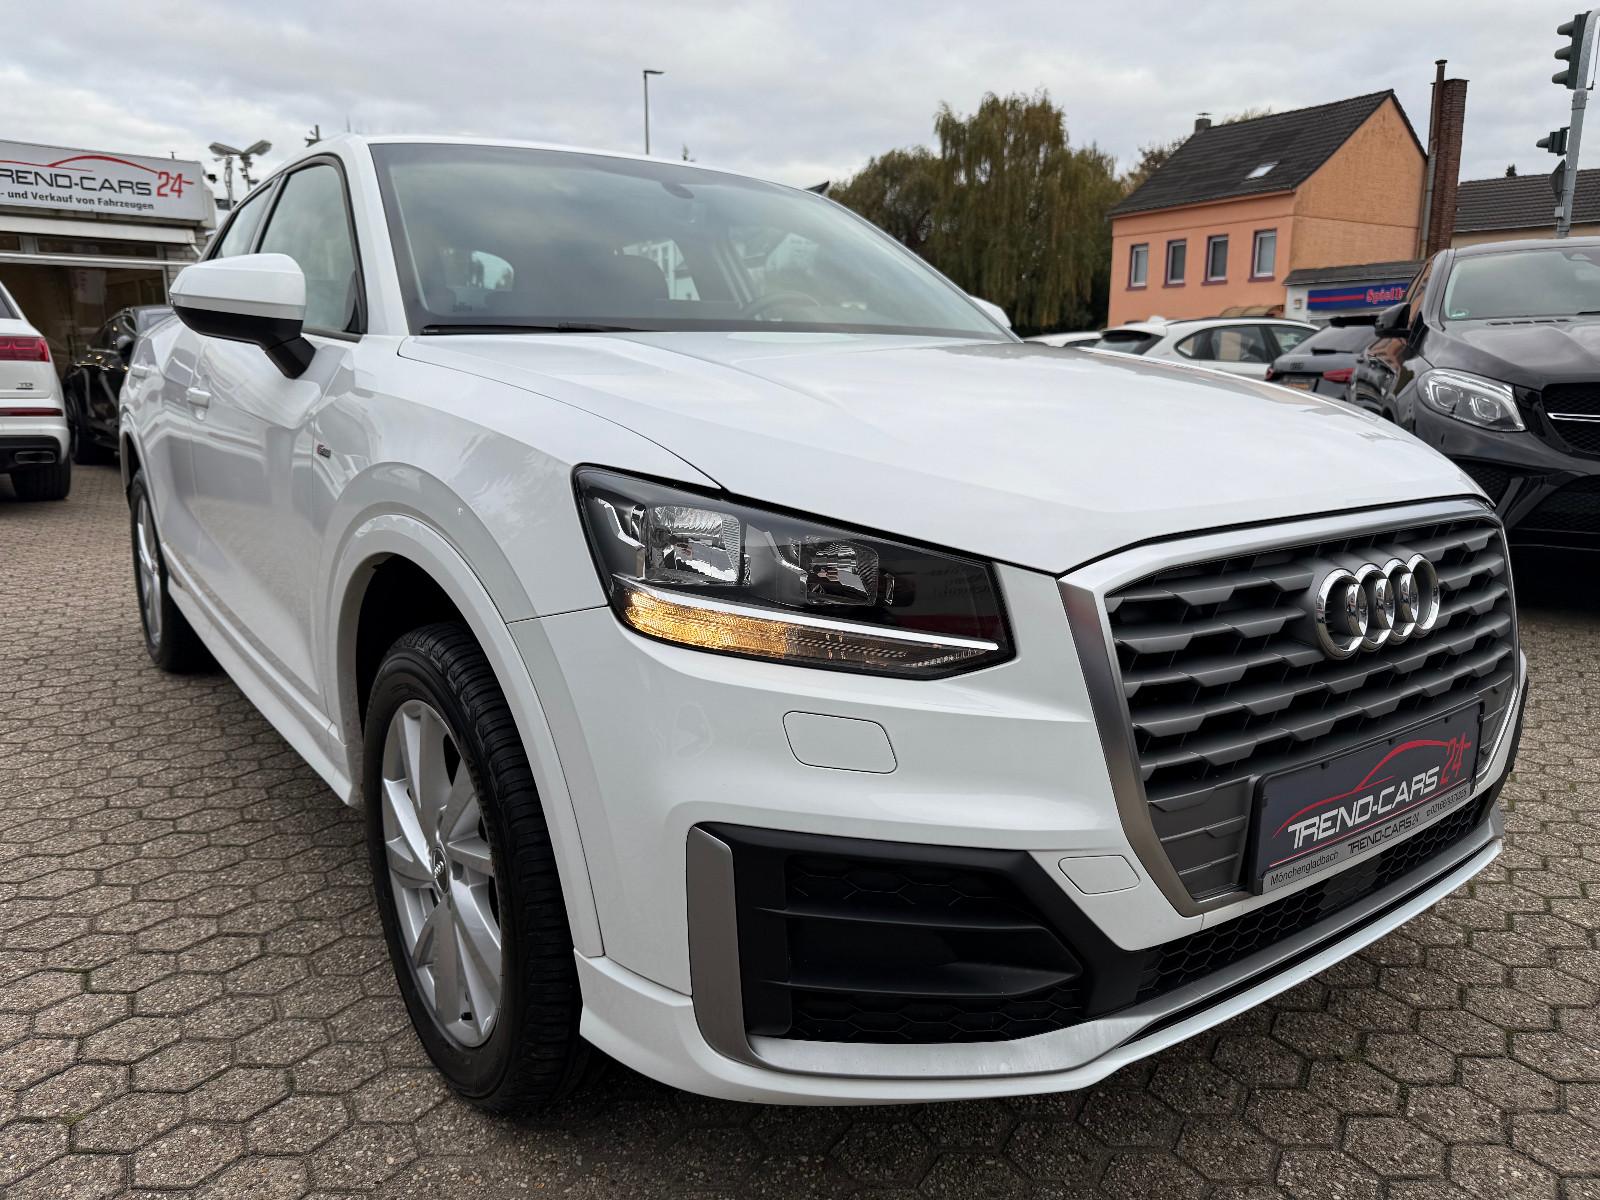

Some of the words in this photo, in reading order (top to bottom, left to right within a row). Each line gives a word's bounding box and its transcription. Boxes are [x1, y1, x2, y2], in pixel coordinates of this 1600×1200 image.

[8, 190, 28, 200] und
[31, 192, 73, 204] Verkauf
[75, 195, 95, 206] von
[97, 197, 154, 210] Fahrzeugen
[157, 171, 184, 198] 24
[1287, 766, 1440, 850] TREND-CARS
[1440, 732, 1471, 785] 24
[1270, 851, 1339, 886] Mönchengladbach
